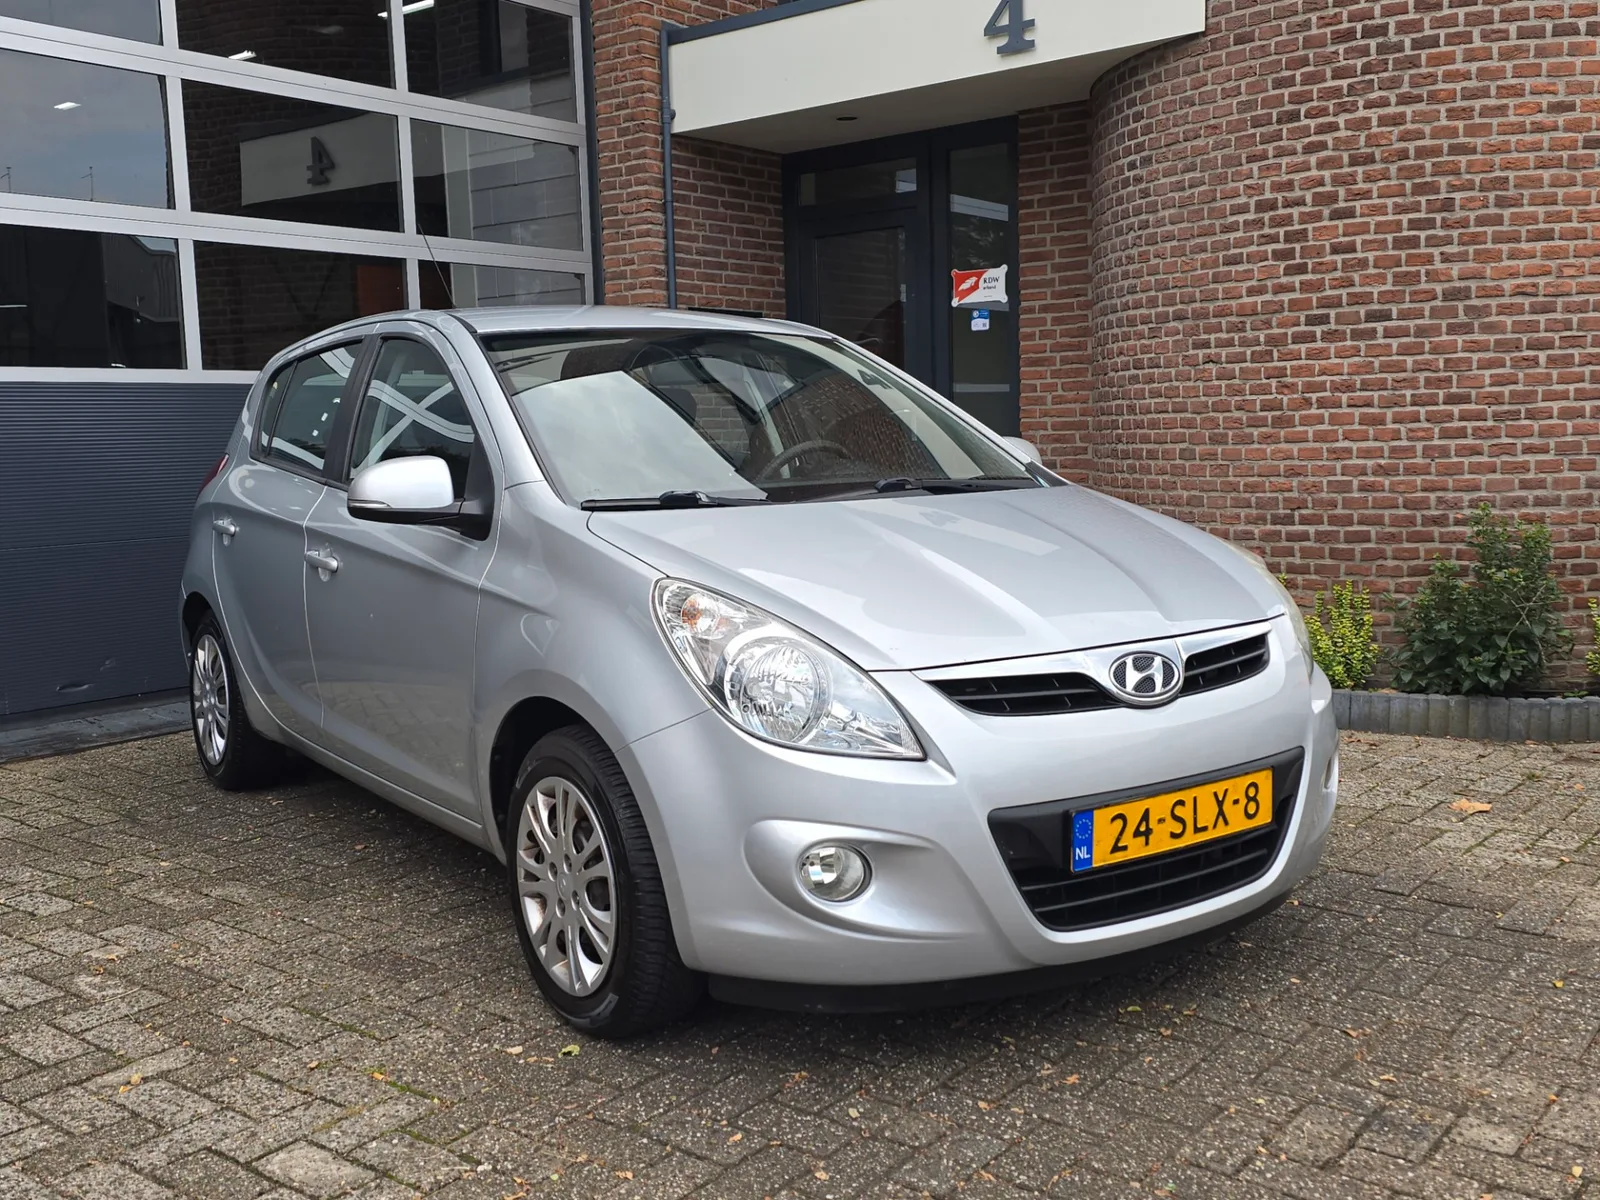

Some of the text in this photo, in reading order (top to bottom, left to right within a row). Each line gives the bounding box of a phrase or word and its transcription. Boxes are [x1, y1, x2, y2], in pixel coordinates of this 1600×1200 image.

[984, 0, 1035, 54] 4
[983, 276, 1000, 284] RDW
[1109, 781, 1260, 855] 24-SLX-8
[1075, 846, 1091, 861] NL
